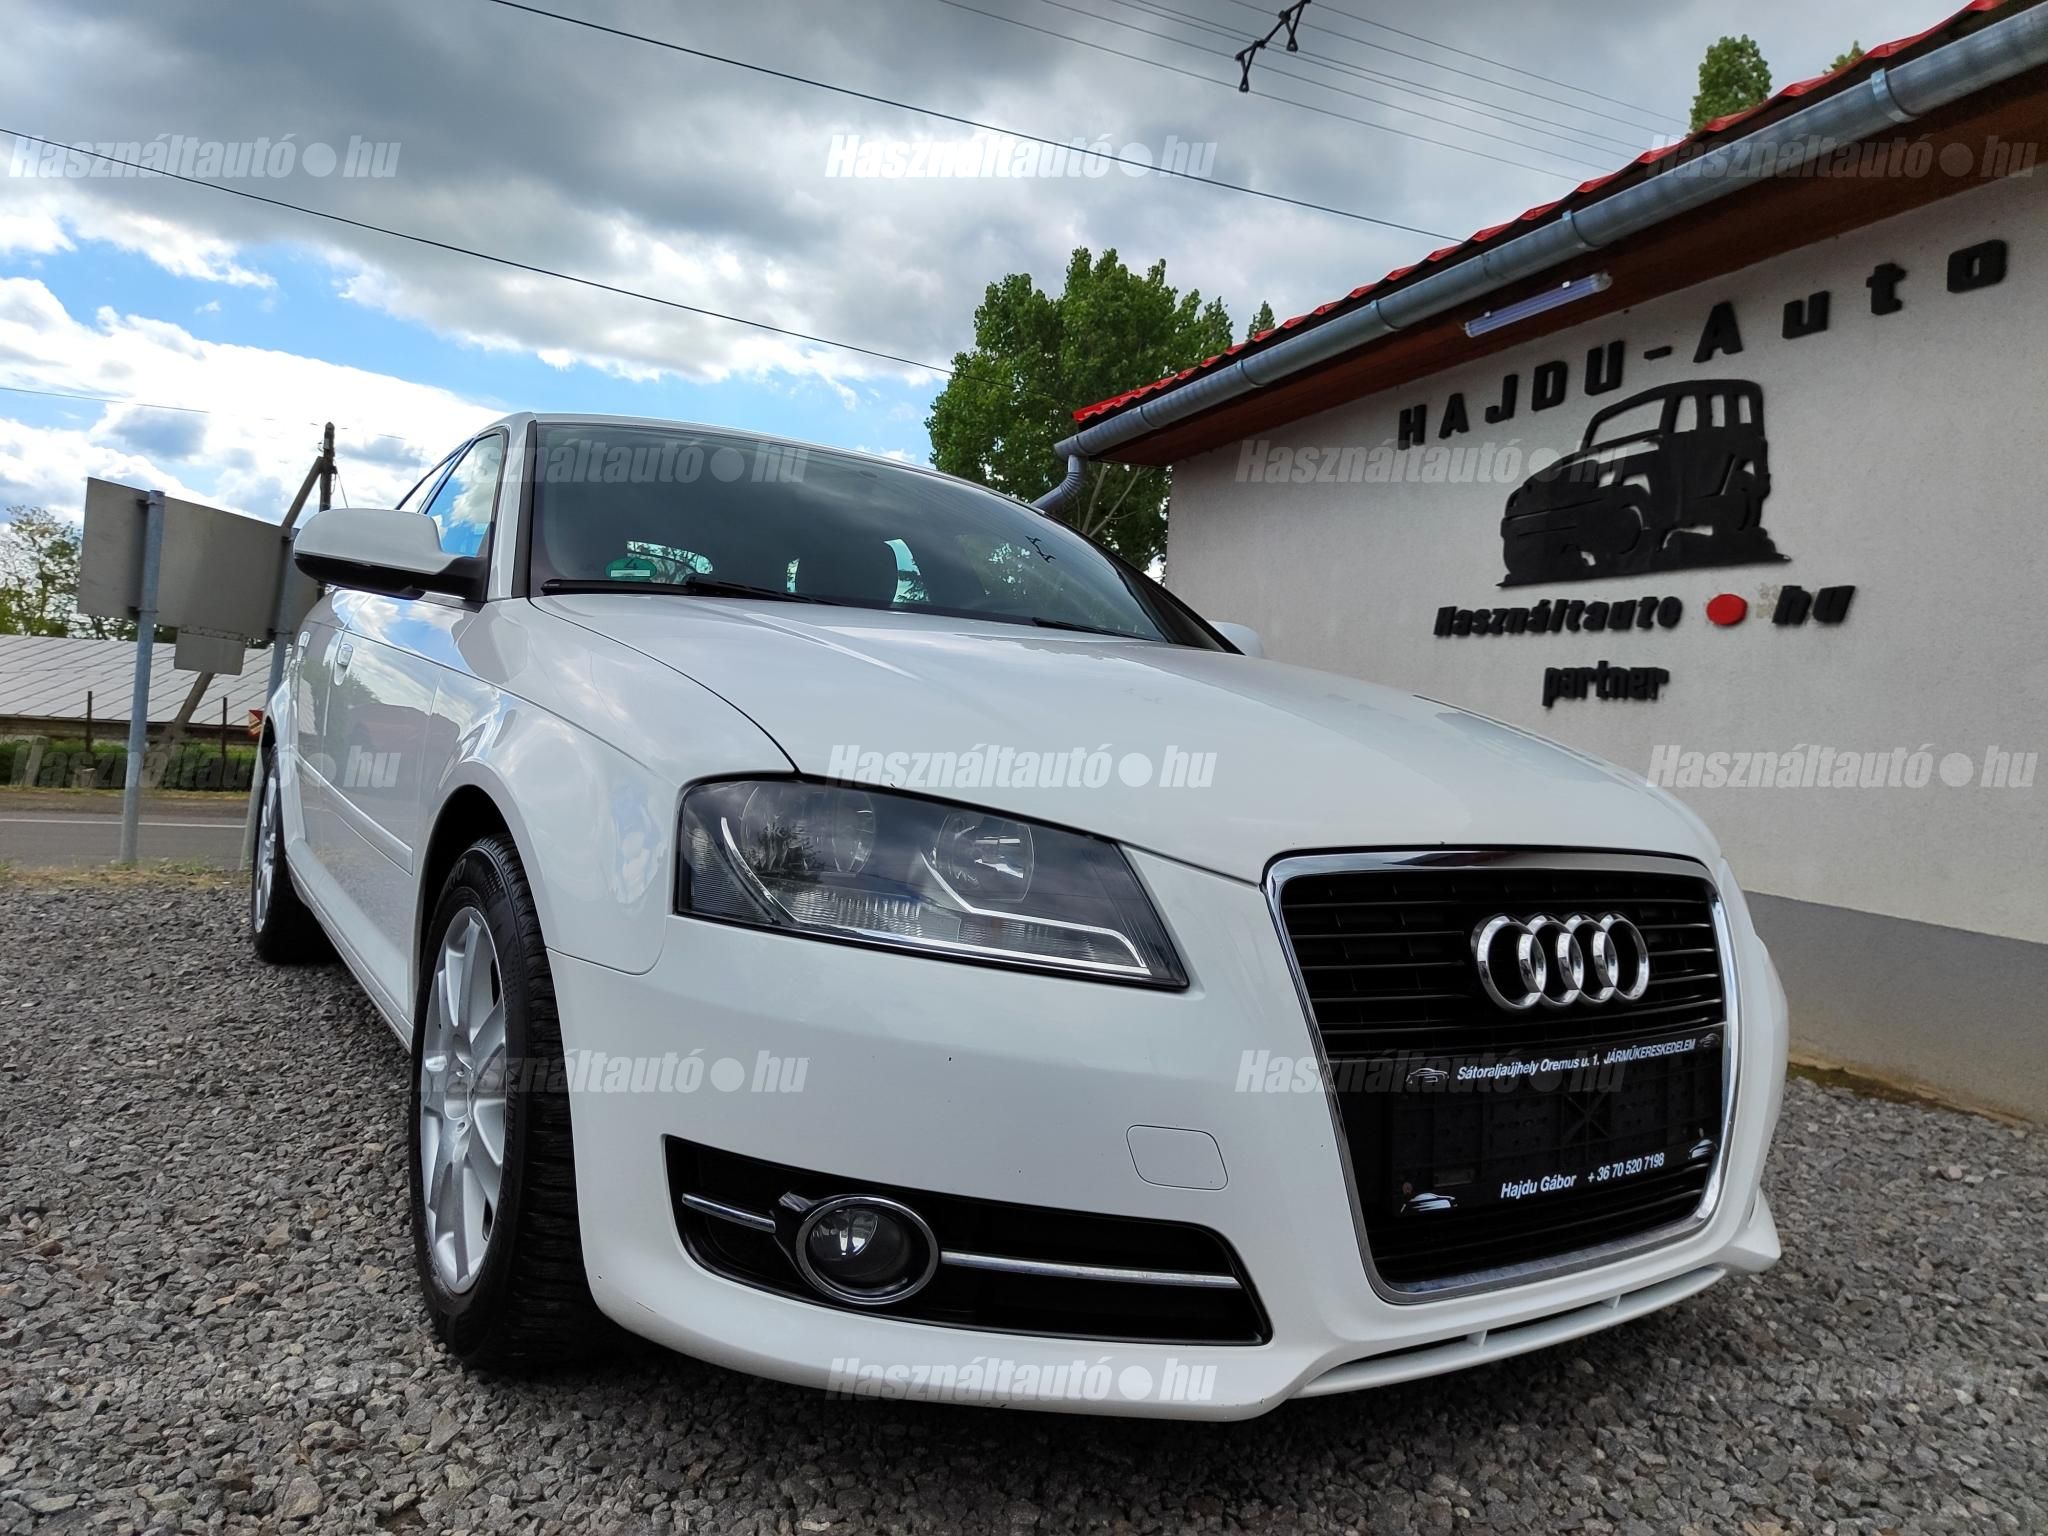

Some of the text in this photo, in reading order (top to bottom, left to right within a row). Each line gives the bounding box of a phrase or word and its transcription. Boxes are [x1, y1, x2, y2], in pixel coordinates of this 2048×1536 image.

[1542, 660, 1670, 707] partner
[1456, 1039, 1696, 1081] Sátoraljaújhely Oremus u. 1. JÁRMŰKERESKEDELEM
[1500, 1180, 1538, 1199] Hajdu
[1540, 1174, 1577, 1192] Gábor
[1611, 1162, 1625, 1178] 70
[1625, 1158, 1643, 1175] 520
[1643, 1152, 1665, 1170] 7198
